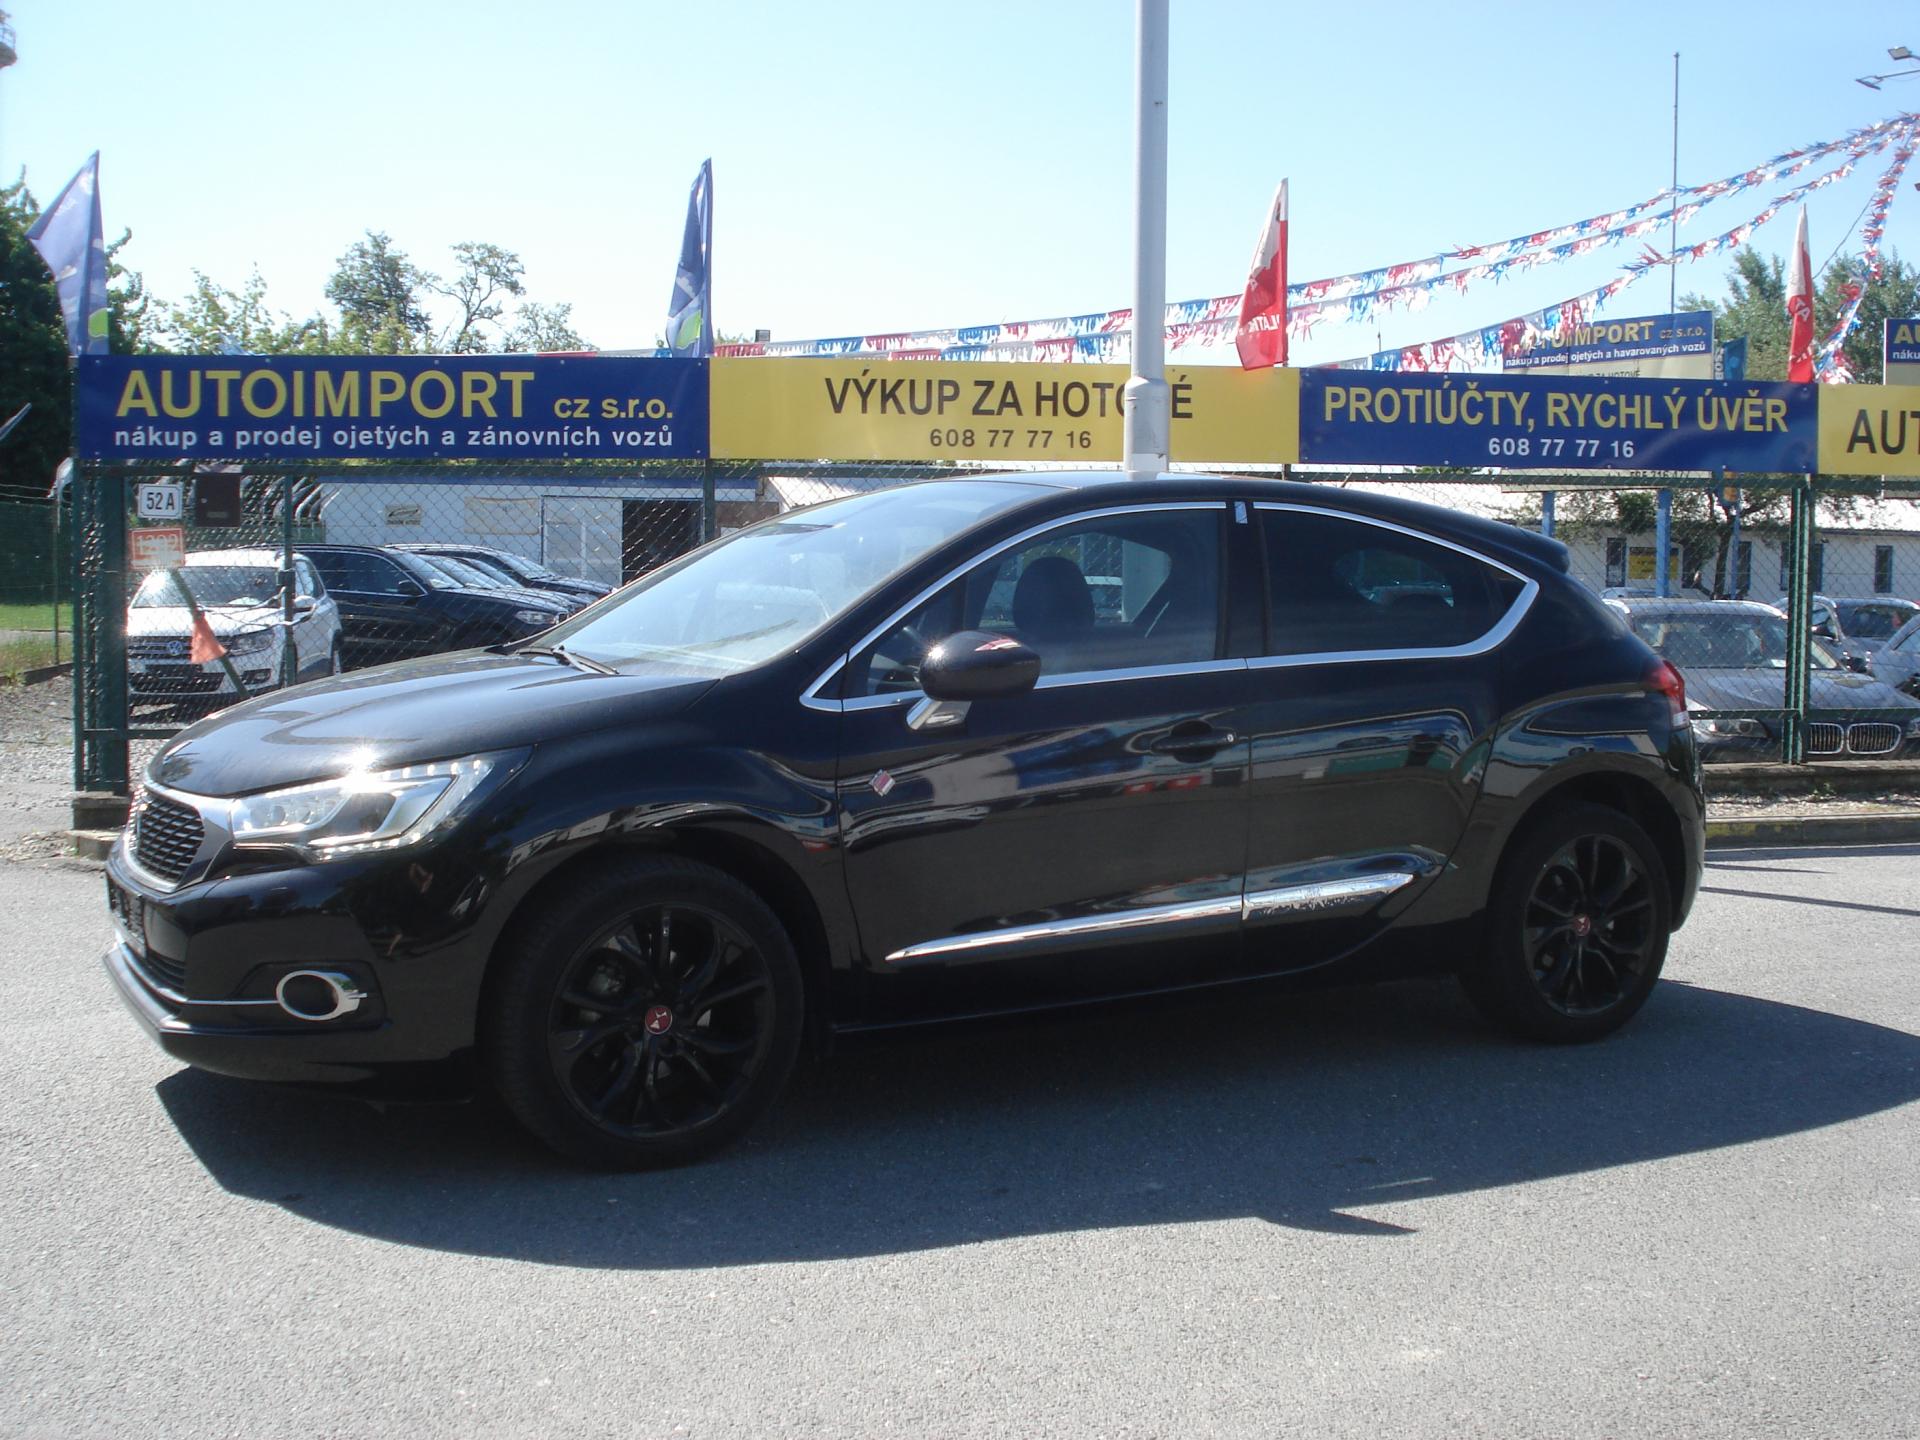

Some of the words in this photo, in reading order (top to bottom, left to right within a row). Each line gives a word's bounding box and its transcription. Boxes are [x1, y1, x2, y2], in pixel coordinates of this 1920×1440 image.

[1520, 321, 1655, 350] OIMPORT
[1534, 357, 1540, 365] a
[1541, 352, 1569, 366] prodej
[1571, 349, 1604, 362] ojetých
[1605, 351, 1612, 359] a
[1614, 343, 1680, 358] havarovaných
[1682, 342, 1706, 353] vozů
[115, 369, 535, 419] AUTOIMPORT
[554, 398, 590, 419] cz
[601, 398, 673, 419] s.r.o.
[825, 368, 961, 416] VÝKUP
[971, 380, 1024, 417] ZA
[1035, 374, 1193, 419] HOTÉ
[1324, 381, 1536, 433] PROTIÚČTY,
[1547, 387, 1687, 429] RYCHLÝ
[1697, 388, 1789, 433] ÚVĚR
[115, 426, 198, 450] nákup
[208, 430, 223, 446] a
[236, 426, 322, 450] prodej
[333, 426, 429, 450] ojetých
[441, 430, 455, 446] a
[467, 426, 601, 446] zánovních
[611, 424, 673, 446] vozů
[929, 429, 976, 448] 608
[987, 430, 1014, 448] 77
[1027, 430, 1053, 449] 77
[1066, 431, 1092, 449] 16
[1488, 438, 1530, 456] 608
[1540, 439, 1565, 457] 77
[1575, 440, 1600, 458] 77
[1610, 440, 1635, 458] 16
